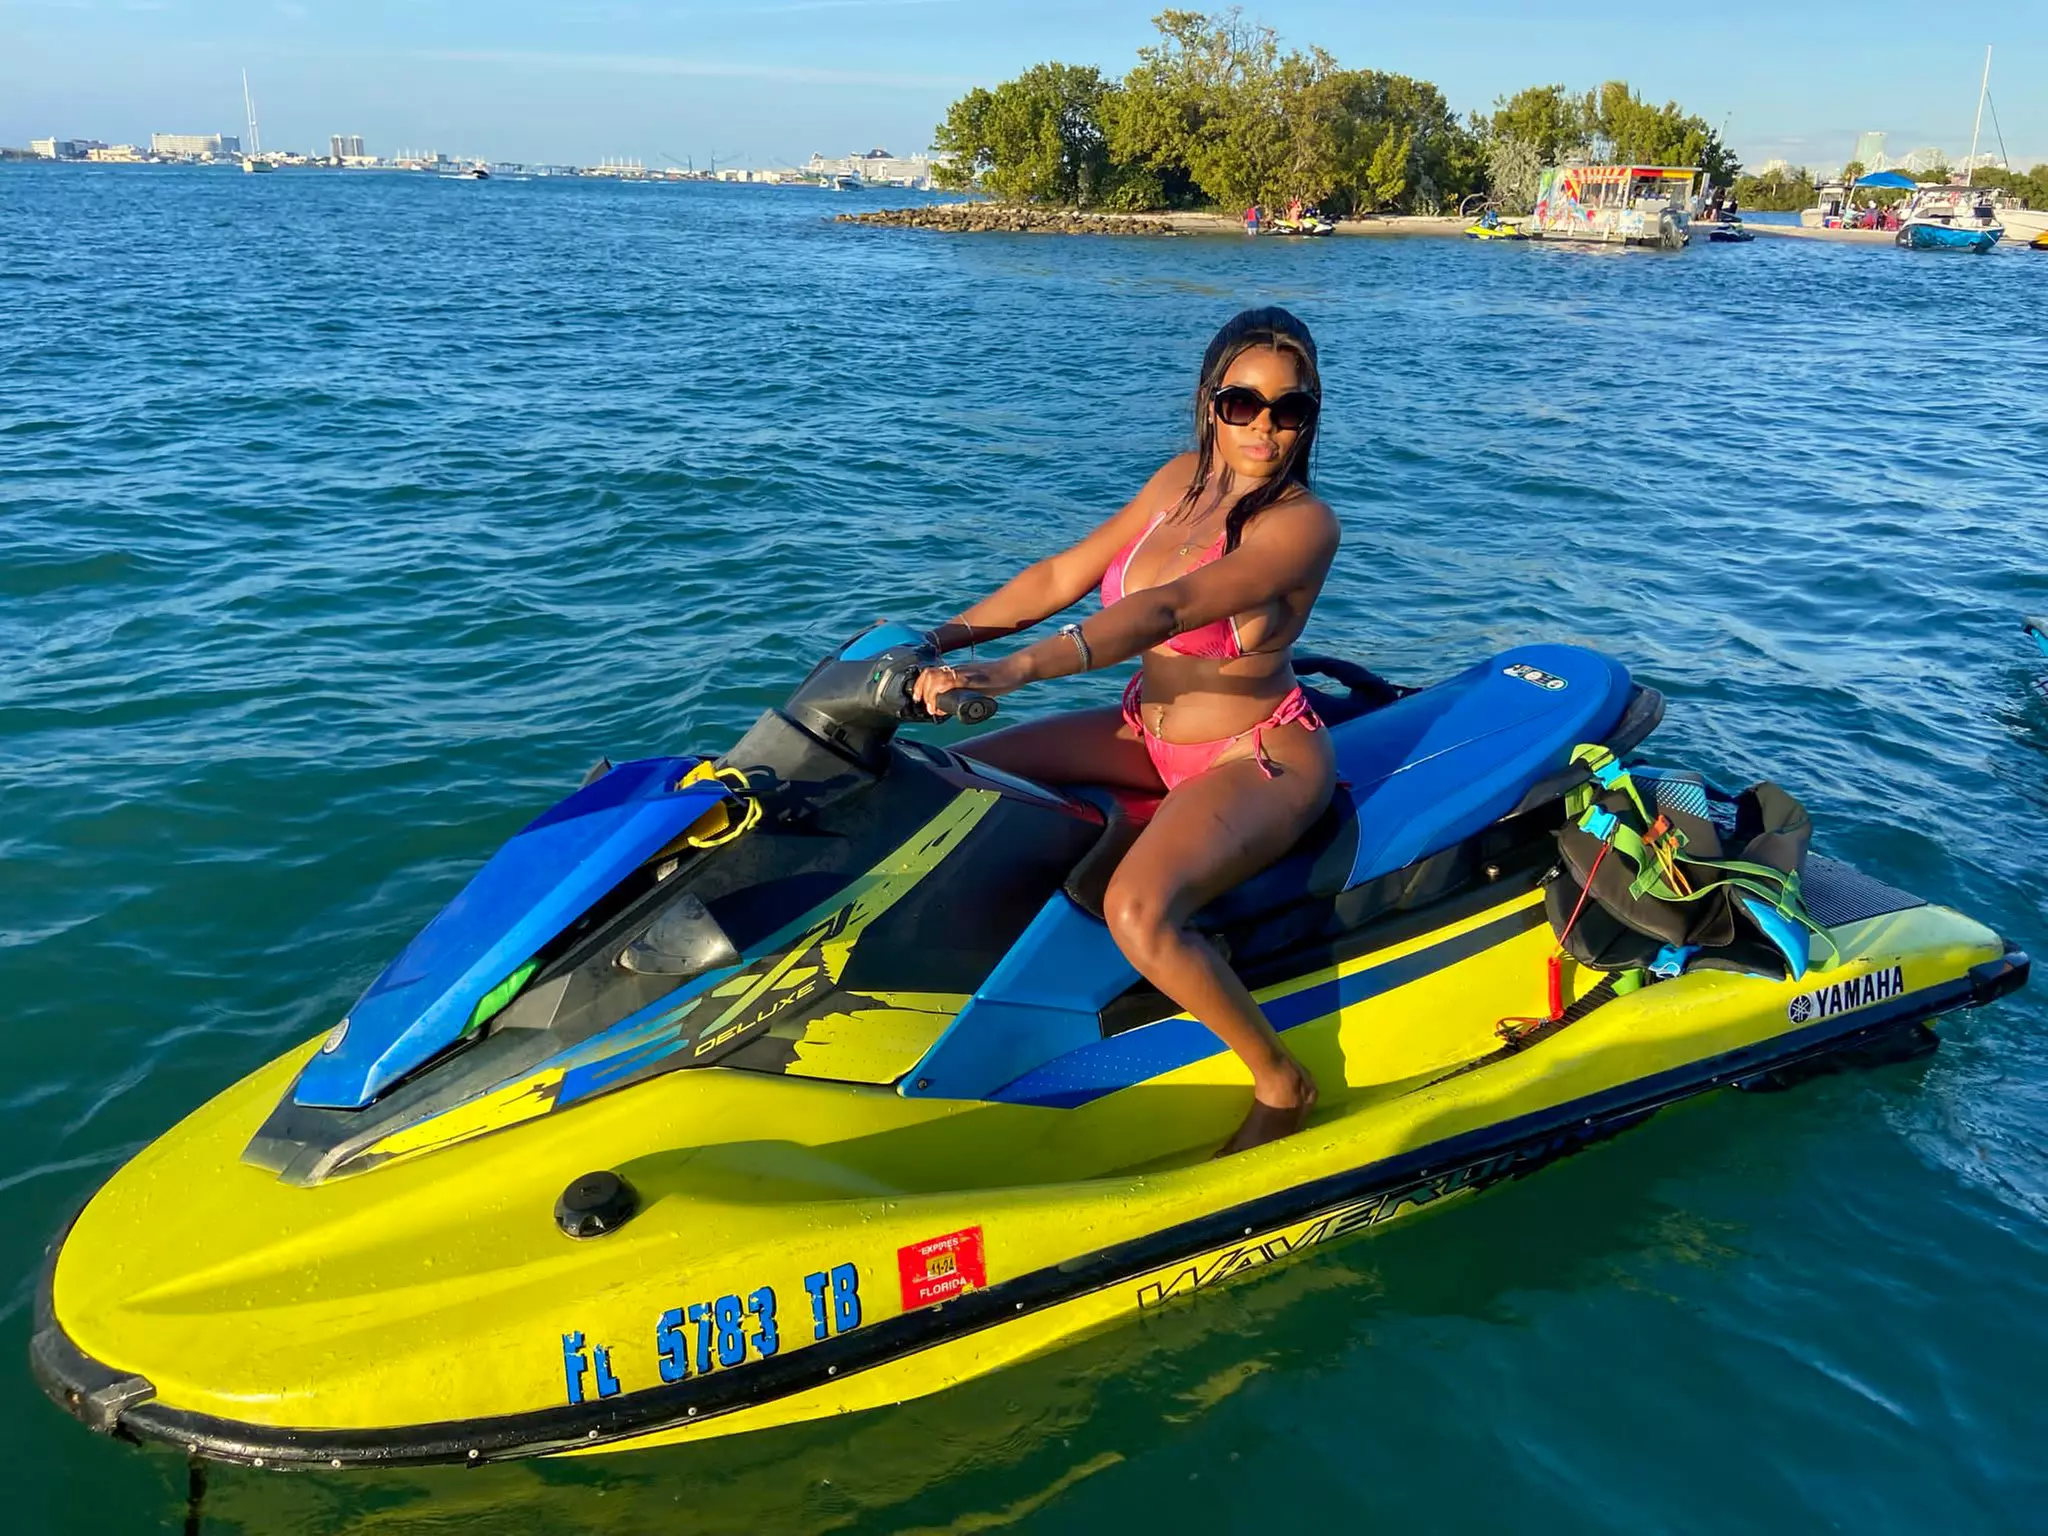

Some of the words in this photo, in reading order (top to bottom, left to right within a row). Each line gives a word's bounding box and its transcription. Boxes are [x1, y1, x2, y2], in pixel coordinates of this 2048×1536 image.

[1816, 965, 1904, 1017] YAMAHA
[694, 979, 816, 1057] DELUXE
[921, 1237, 959, 1256] EXPIRES
[920, 1277, 967, 1298] FLORIDA
[562, 1330, 620, 1404] FL
[656, 1286, 779, 1383] 5783
[804, 1262, 862, 1340] TB
